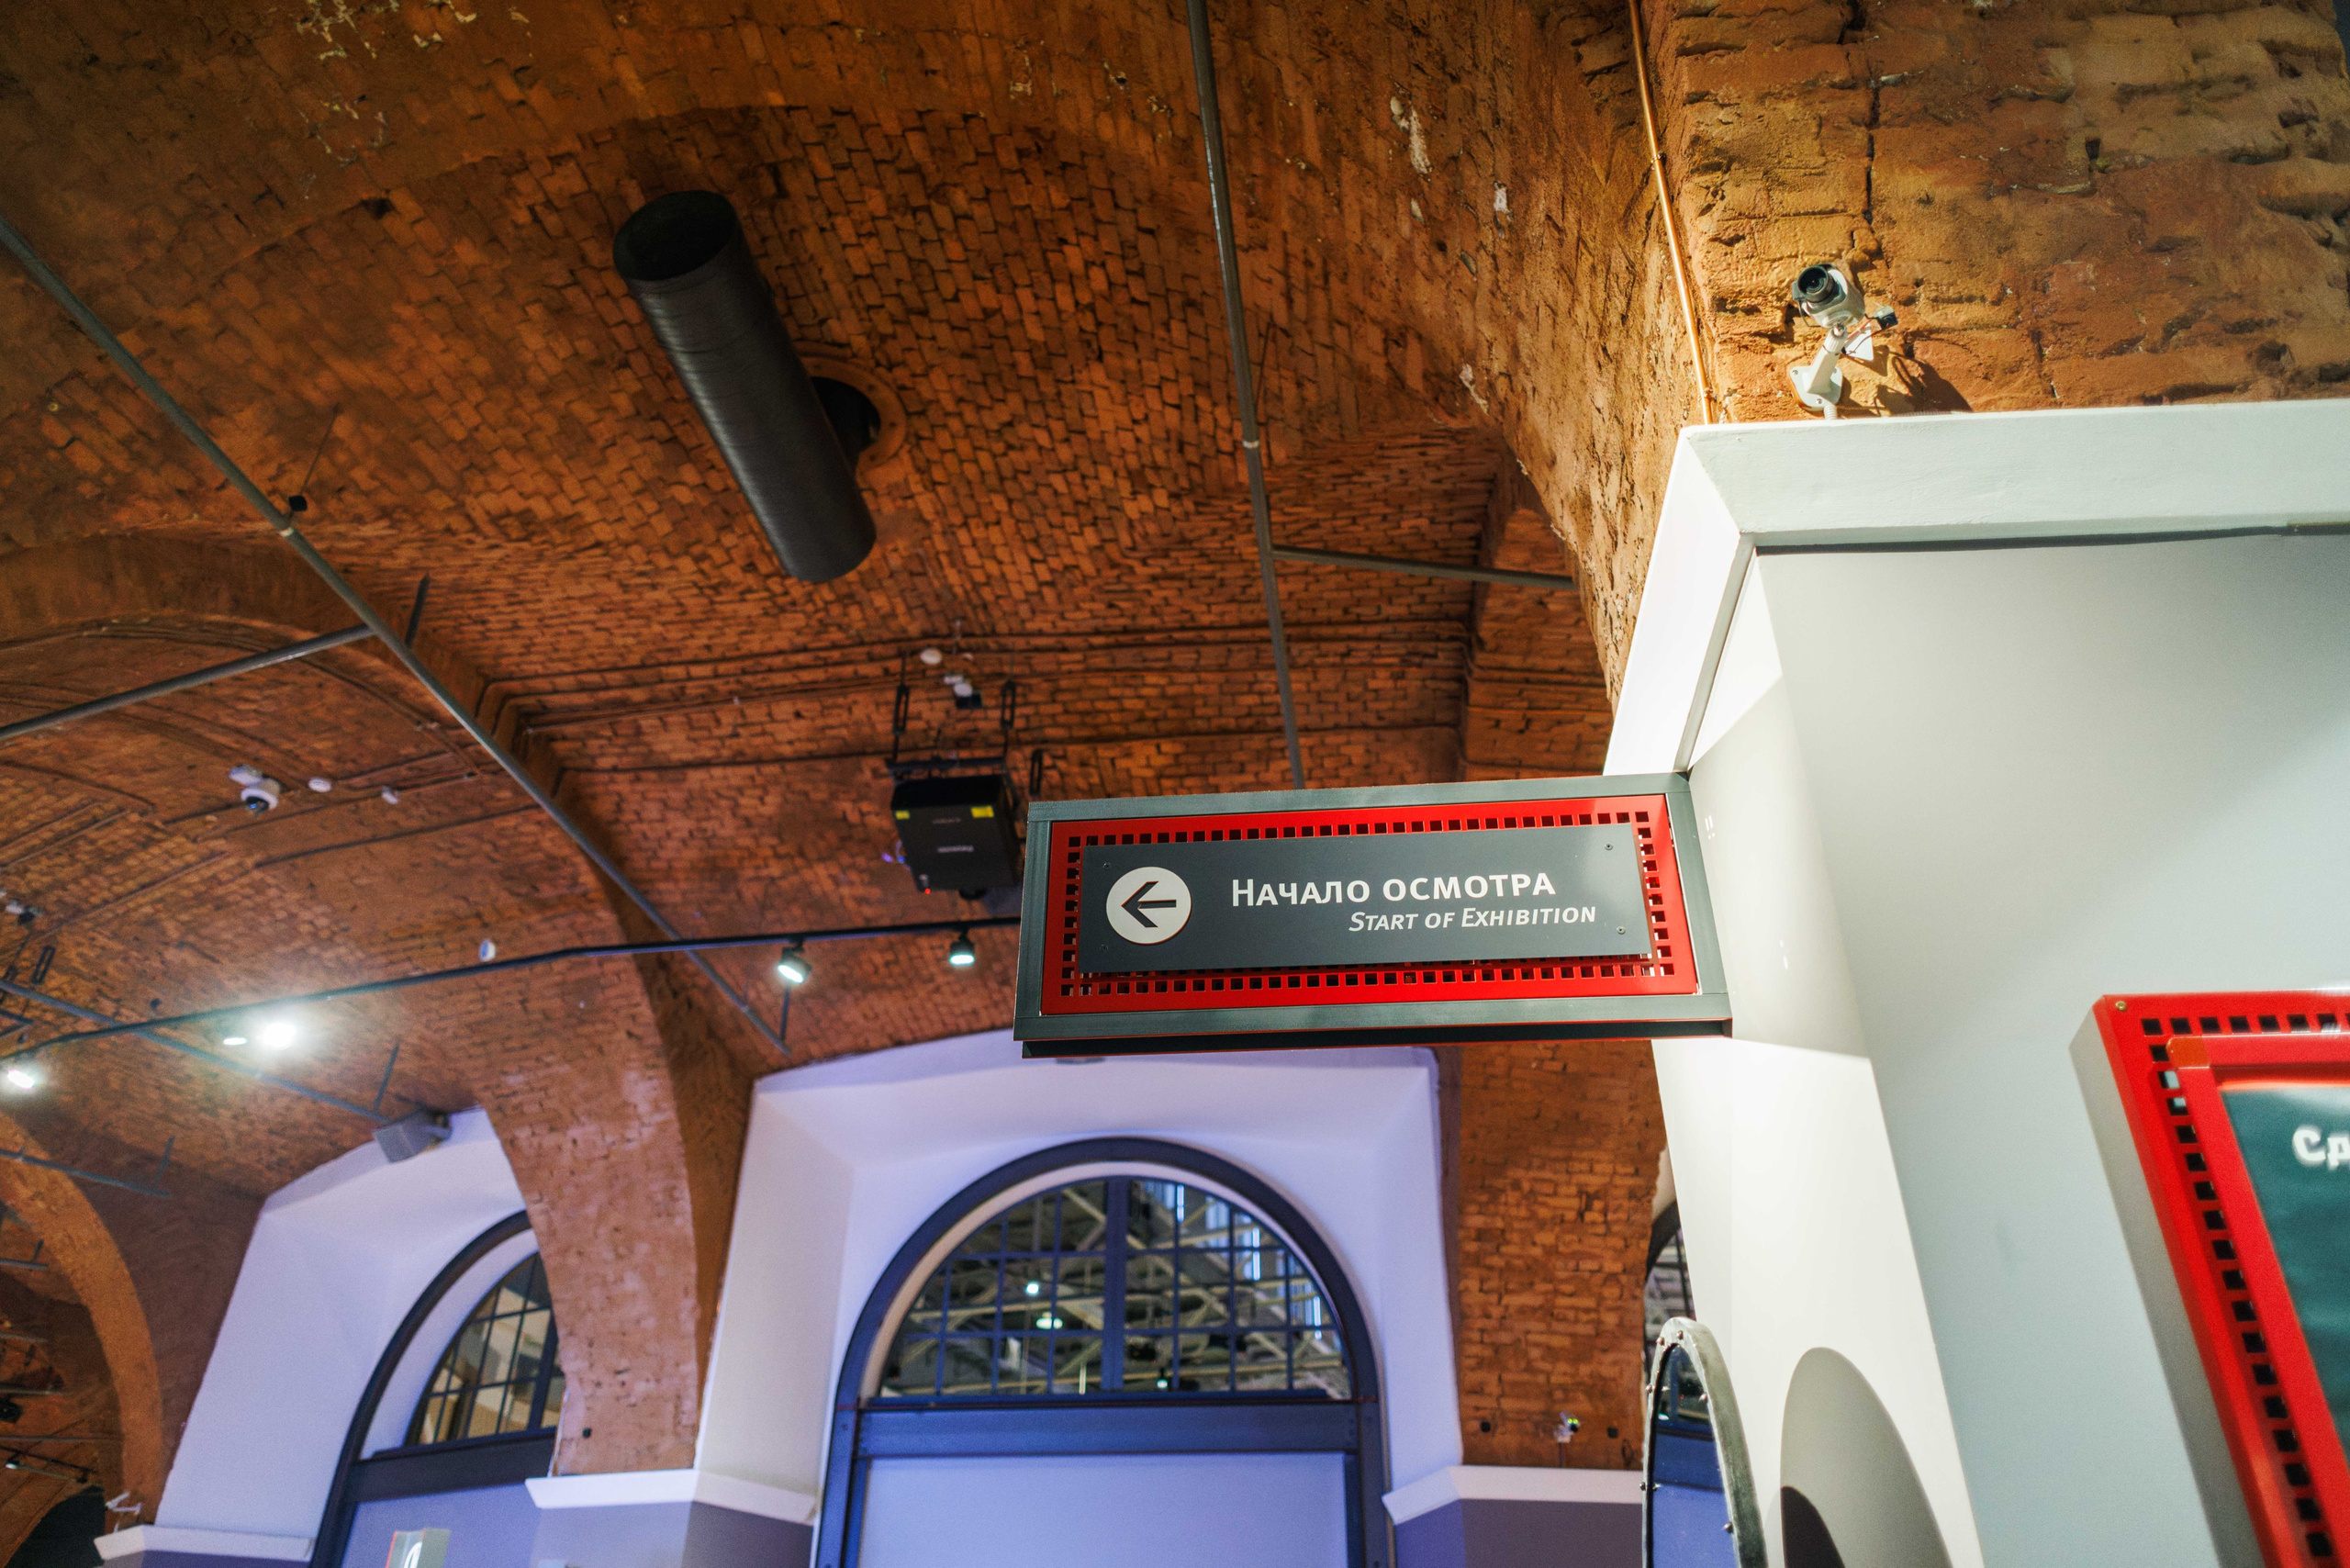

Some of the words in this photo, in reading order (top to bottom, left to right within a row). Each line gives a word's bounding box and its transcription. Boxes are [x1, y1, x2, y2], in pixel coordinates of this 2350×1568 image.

[1231, 879, 1371, 907] НАЧАЛО
[1382, 872, 1556, 902] ОСМОТРА
[1348, 911, 1419, 932] START
[1424, 912, 1456, 929] OF
[1460, 905, 1596, 928] EXHIBITION
